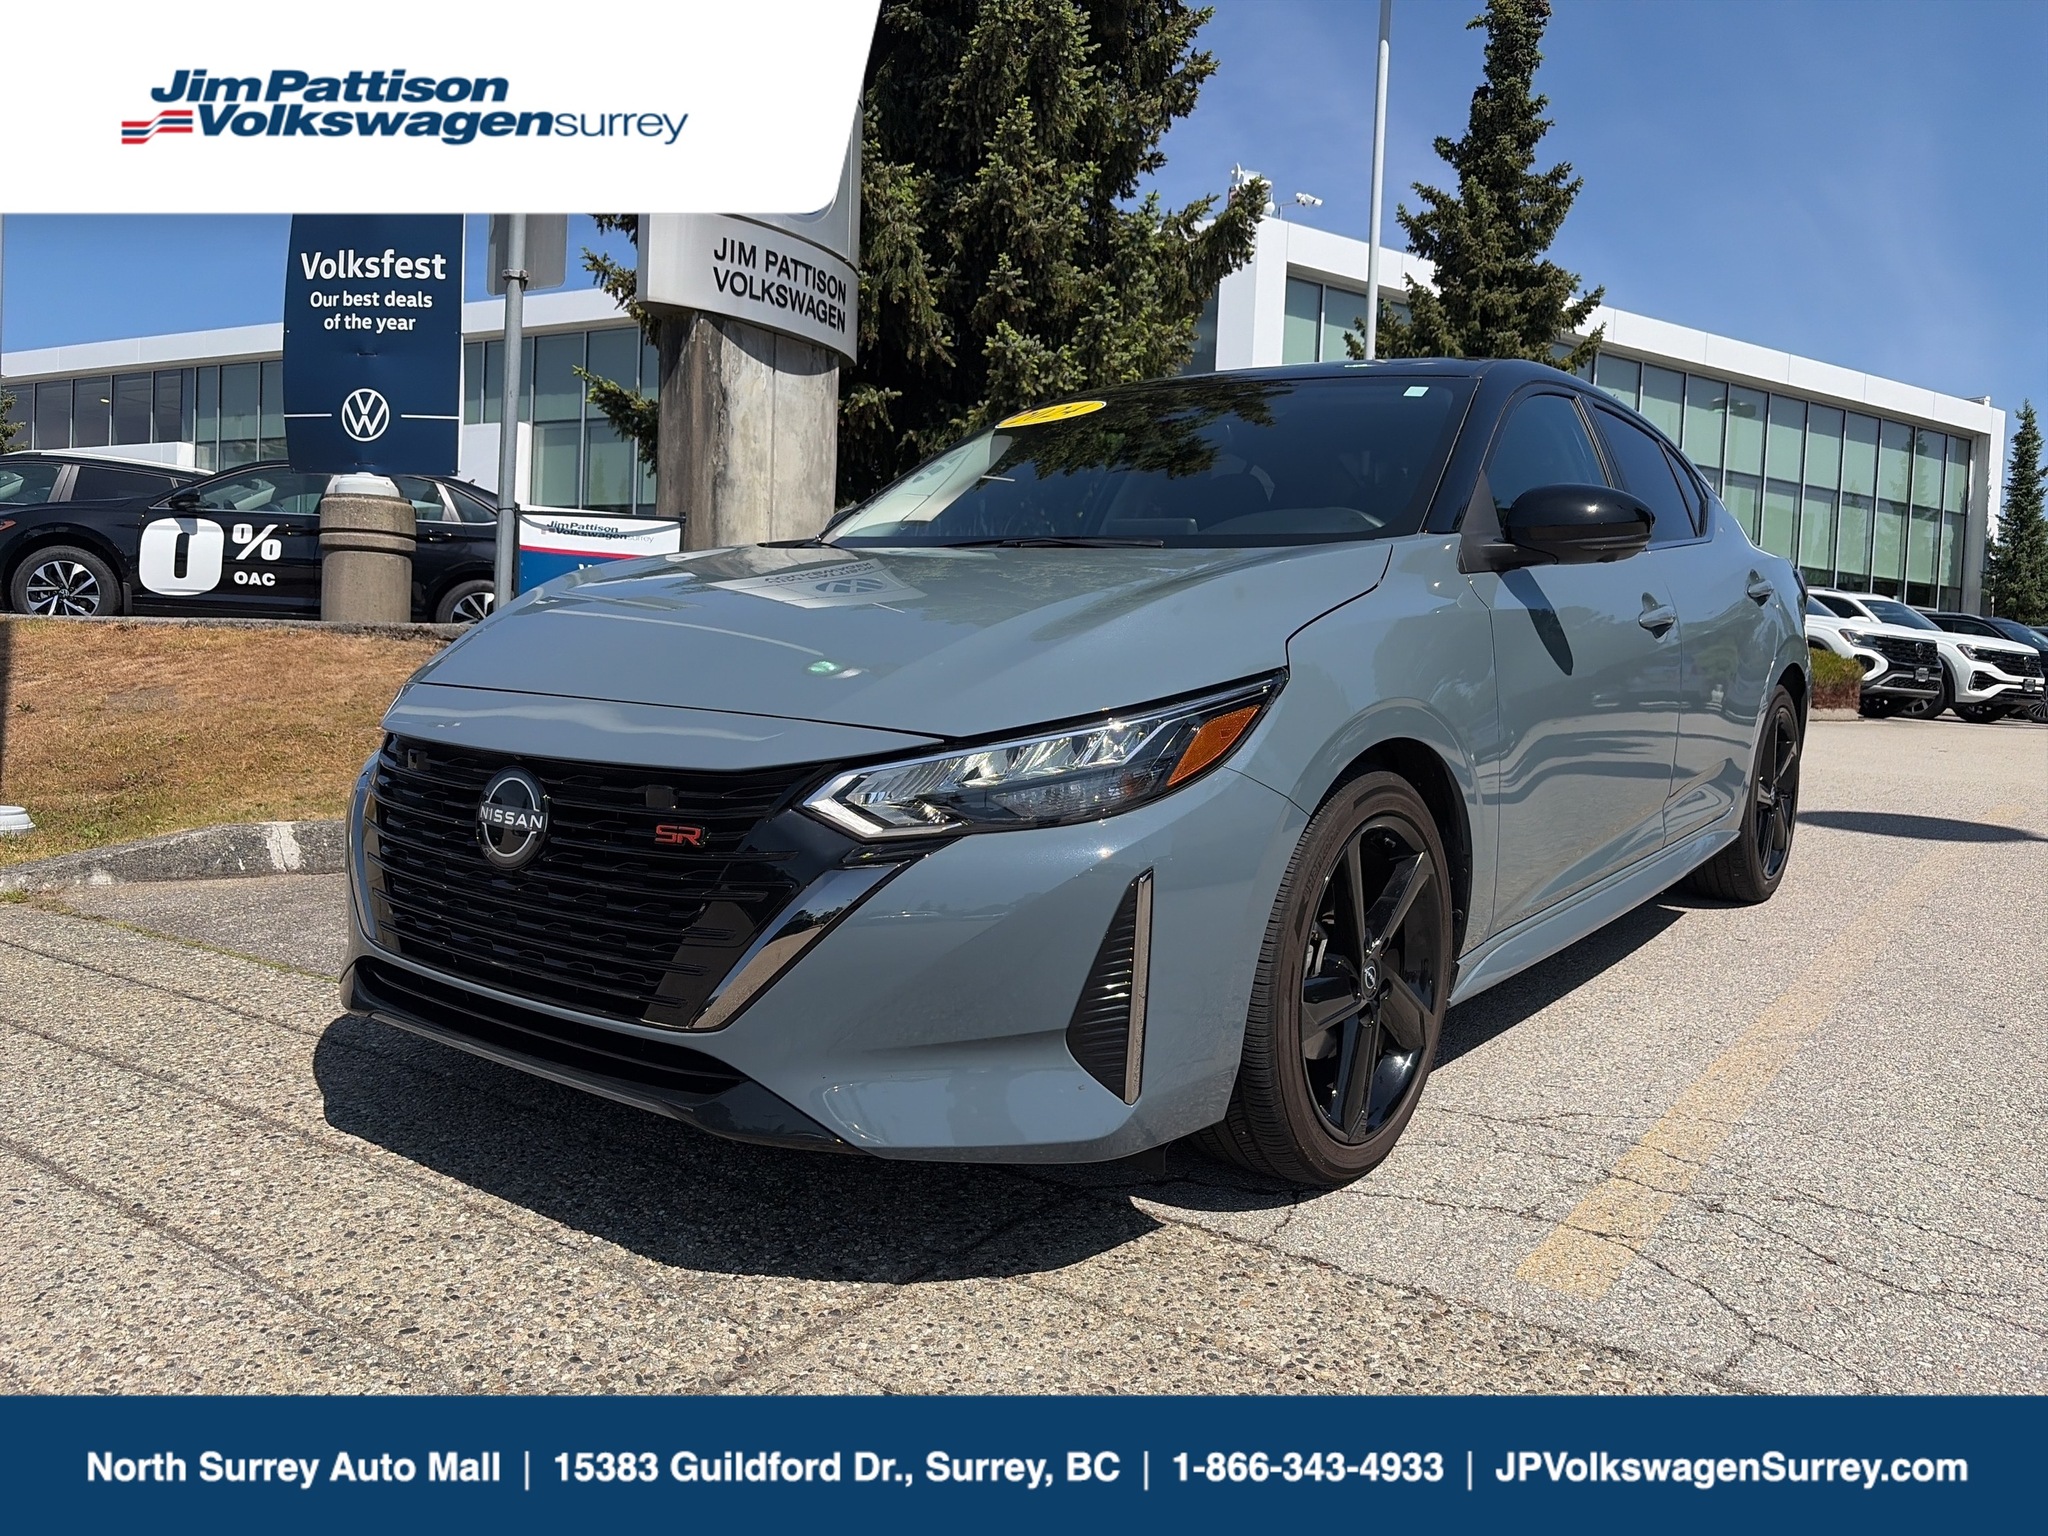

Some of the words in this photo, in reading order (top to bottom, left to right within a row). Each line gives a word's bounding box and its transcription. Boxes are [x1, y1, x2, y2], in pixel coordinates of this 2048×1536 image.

[300, 249, 447, 280] Volksfest
[713, 237, 757, 270] JIM
[765, 248, 847, 306] PATTISON
[310, 291, 339, 308] Our
[342, 290, 380, 307] best
[384, 290, 433, 308] deals
[712, 265, 846, 334] VOLKSWAGEN
[324, 312, 341, 330] of
[344, 312, 372, 330] the
[376, 316, 416, 334] year
[234, 571, 276, 587] OAC
[480, 805, 543, 830] NISSAN
[655, 824, 701, 846] SR
